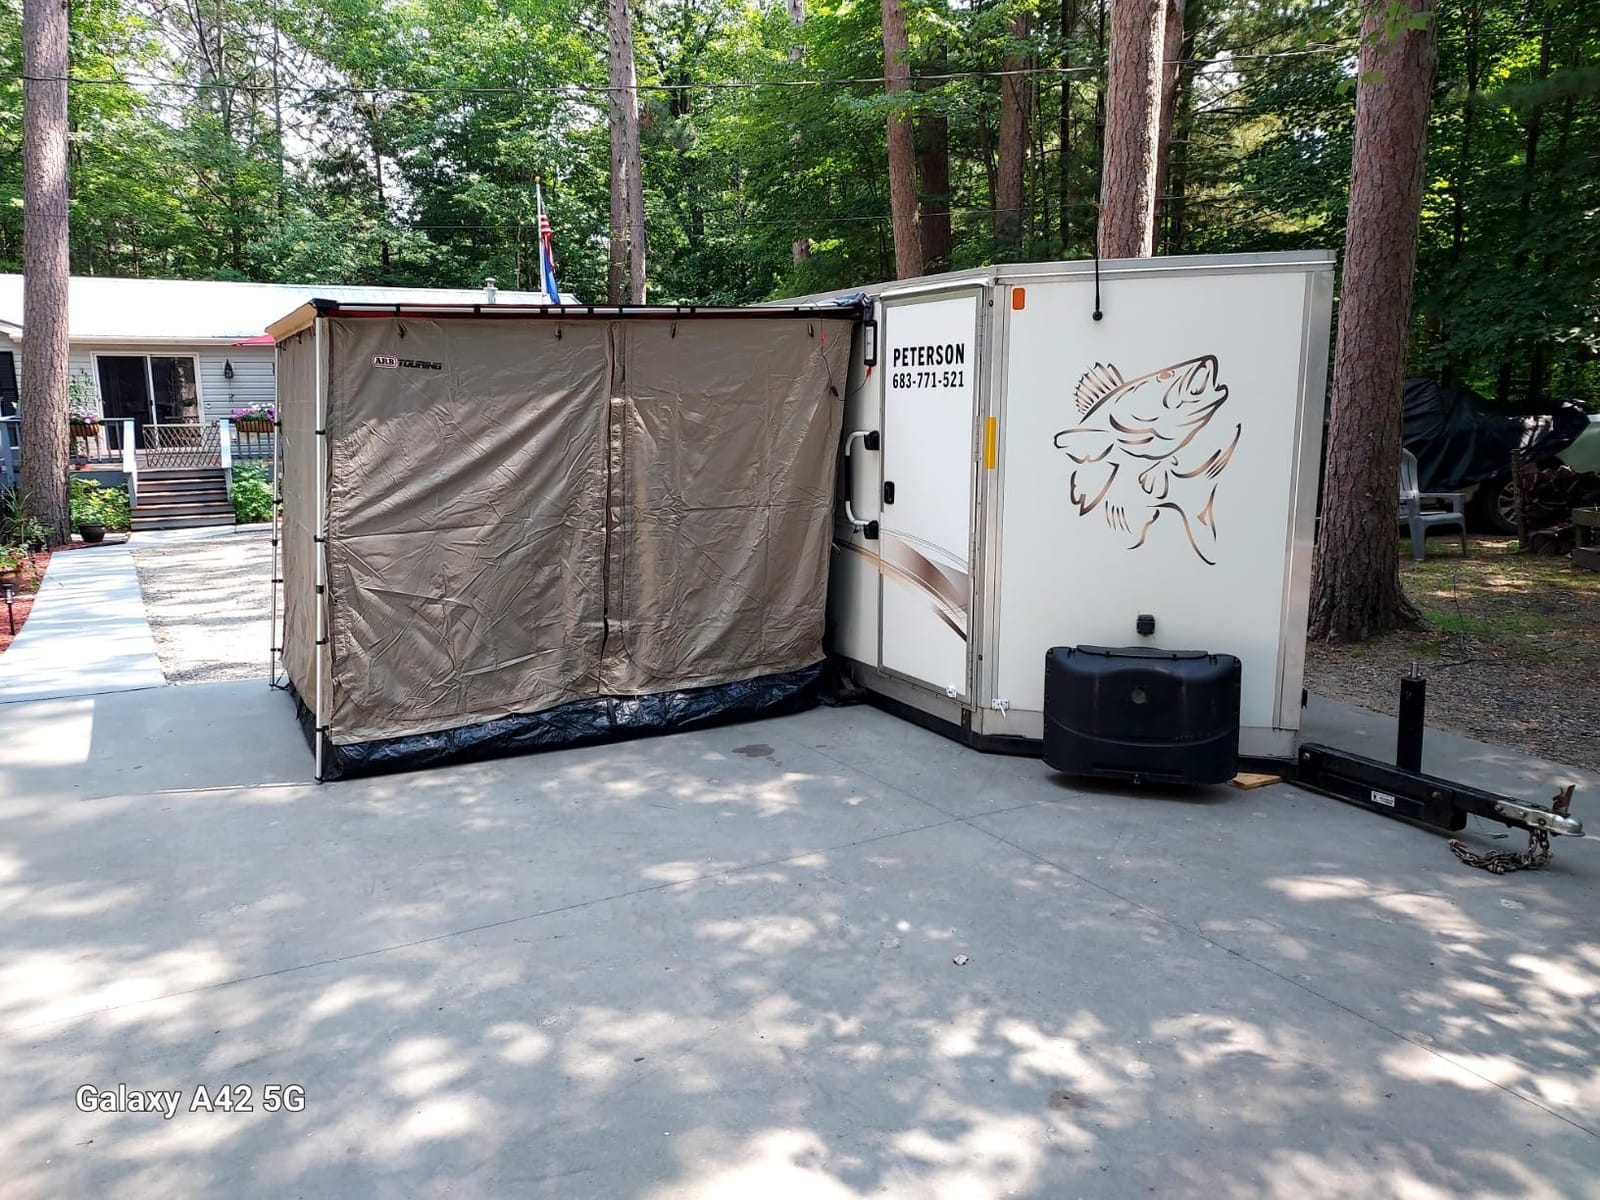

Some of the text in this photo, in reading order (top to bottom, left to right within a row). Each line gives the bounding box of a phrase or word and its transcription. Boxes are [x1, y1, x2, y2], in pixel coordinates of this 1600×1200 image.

[375, 357, 443, 371] ARB TOURING
[893, 343, 965, 367] PETERSON
[892, 370, 964, 389] 683-771-521
